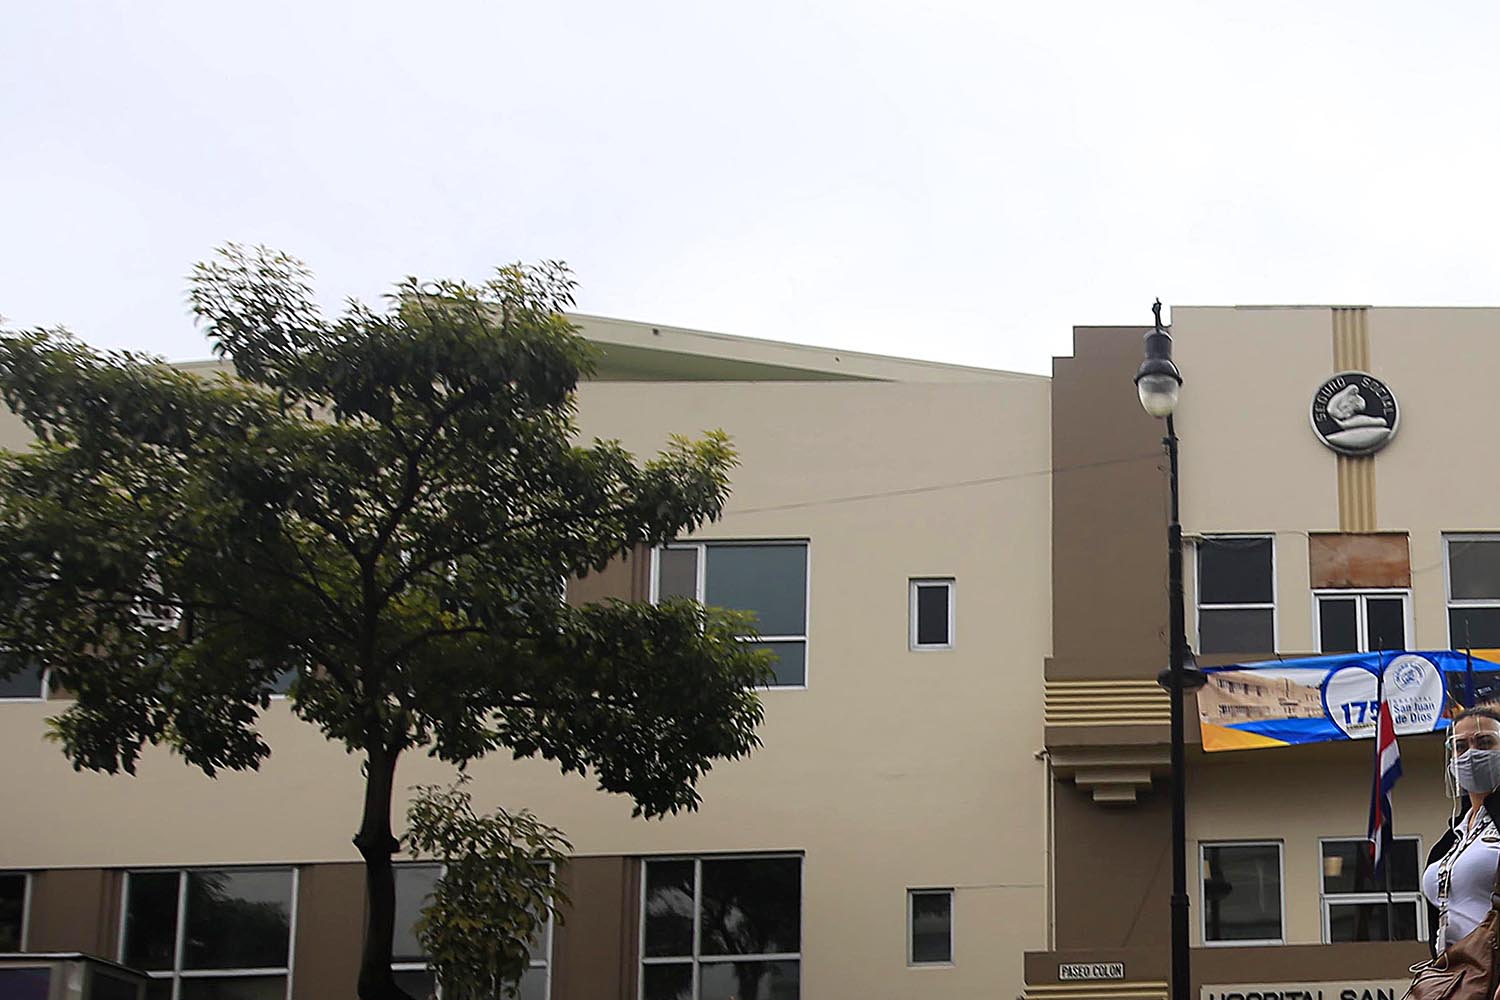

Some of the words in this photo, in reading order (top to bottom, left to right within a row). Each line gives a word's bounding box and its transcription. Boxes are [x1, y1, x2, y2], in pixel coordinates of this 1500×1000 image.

[1340, 701, 1378, 724] 175
[1393, 703, 1412, 713] San
[1413, 702, 1436, 713] Juan
[1395, 713, 1408, 724] de
[1409, 712, 1433, 723] Dios
[1061, 965, 1090, 978] PASEO
